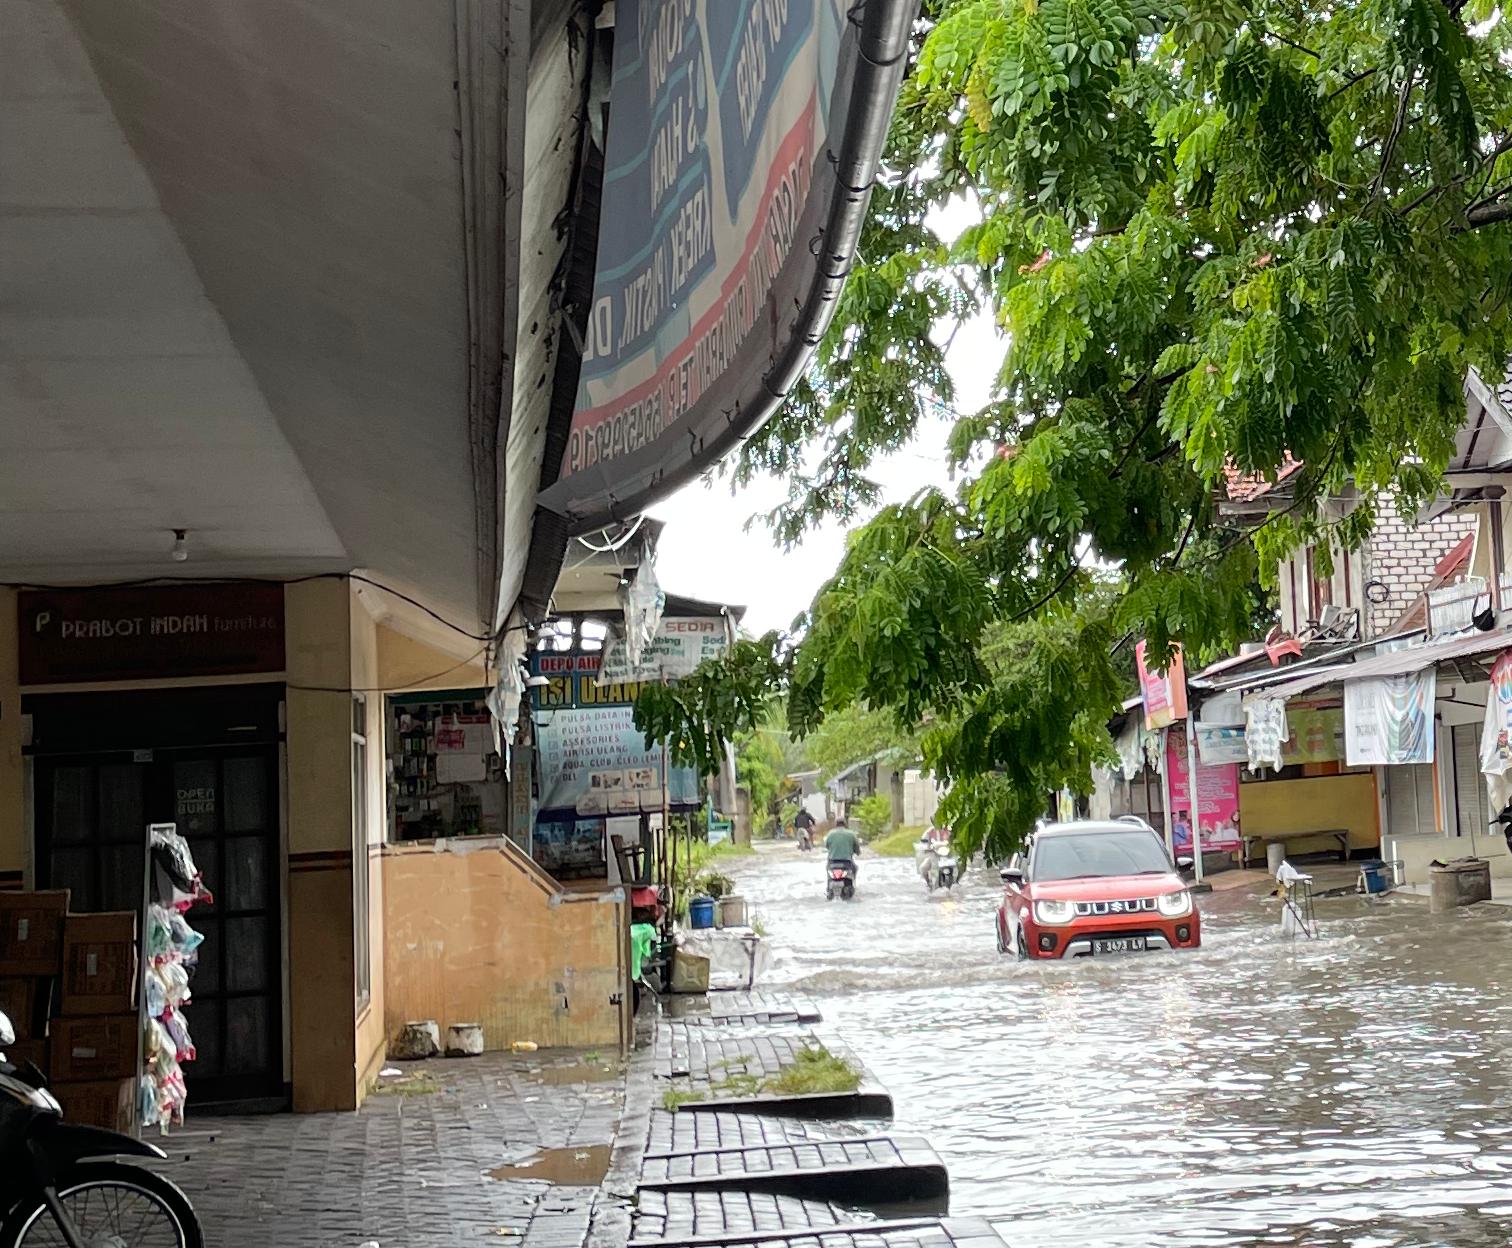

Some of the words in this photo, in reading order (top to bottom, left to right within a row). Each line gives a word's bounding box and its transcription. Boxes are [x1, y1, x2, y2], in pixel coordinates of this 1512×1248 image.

[666, 622, 714, 632] SEDIA
[541, 658, 574, 672] DEPO
[540, 677, 573, 705] ISI
[581, 675, 650, 703] ULAN
[561, 714, 592, 723] PULSA
[562, 725, 592, 735] PULSA
